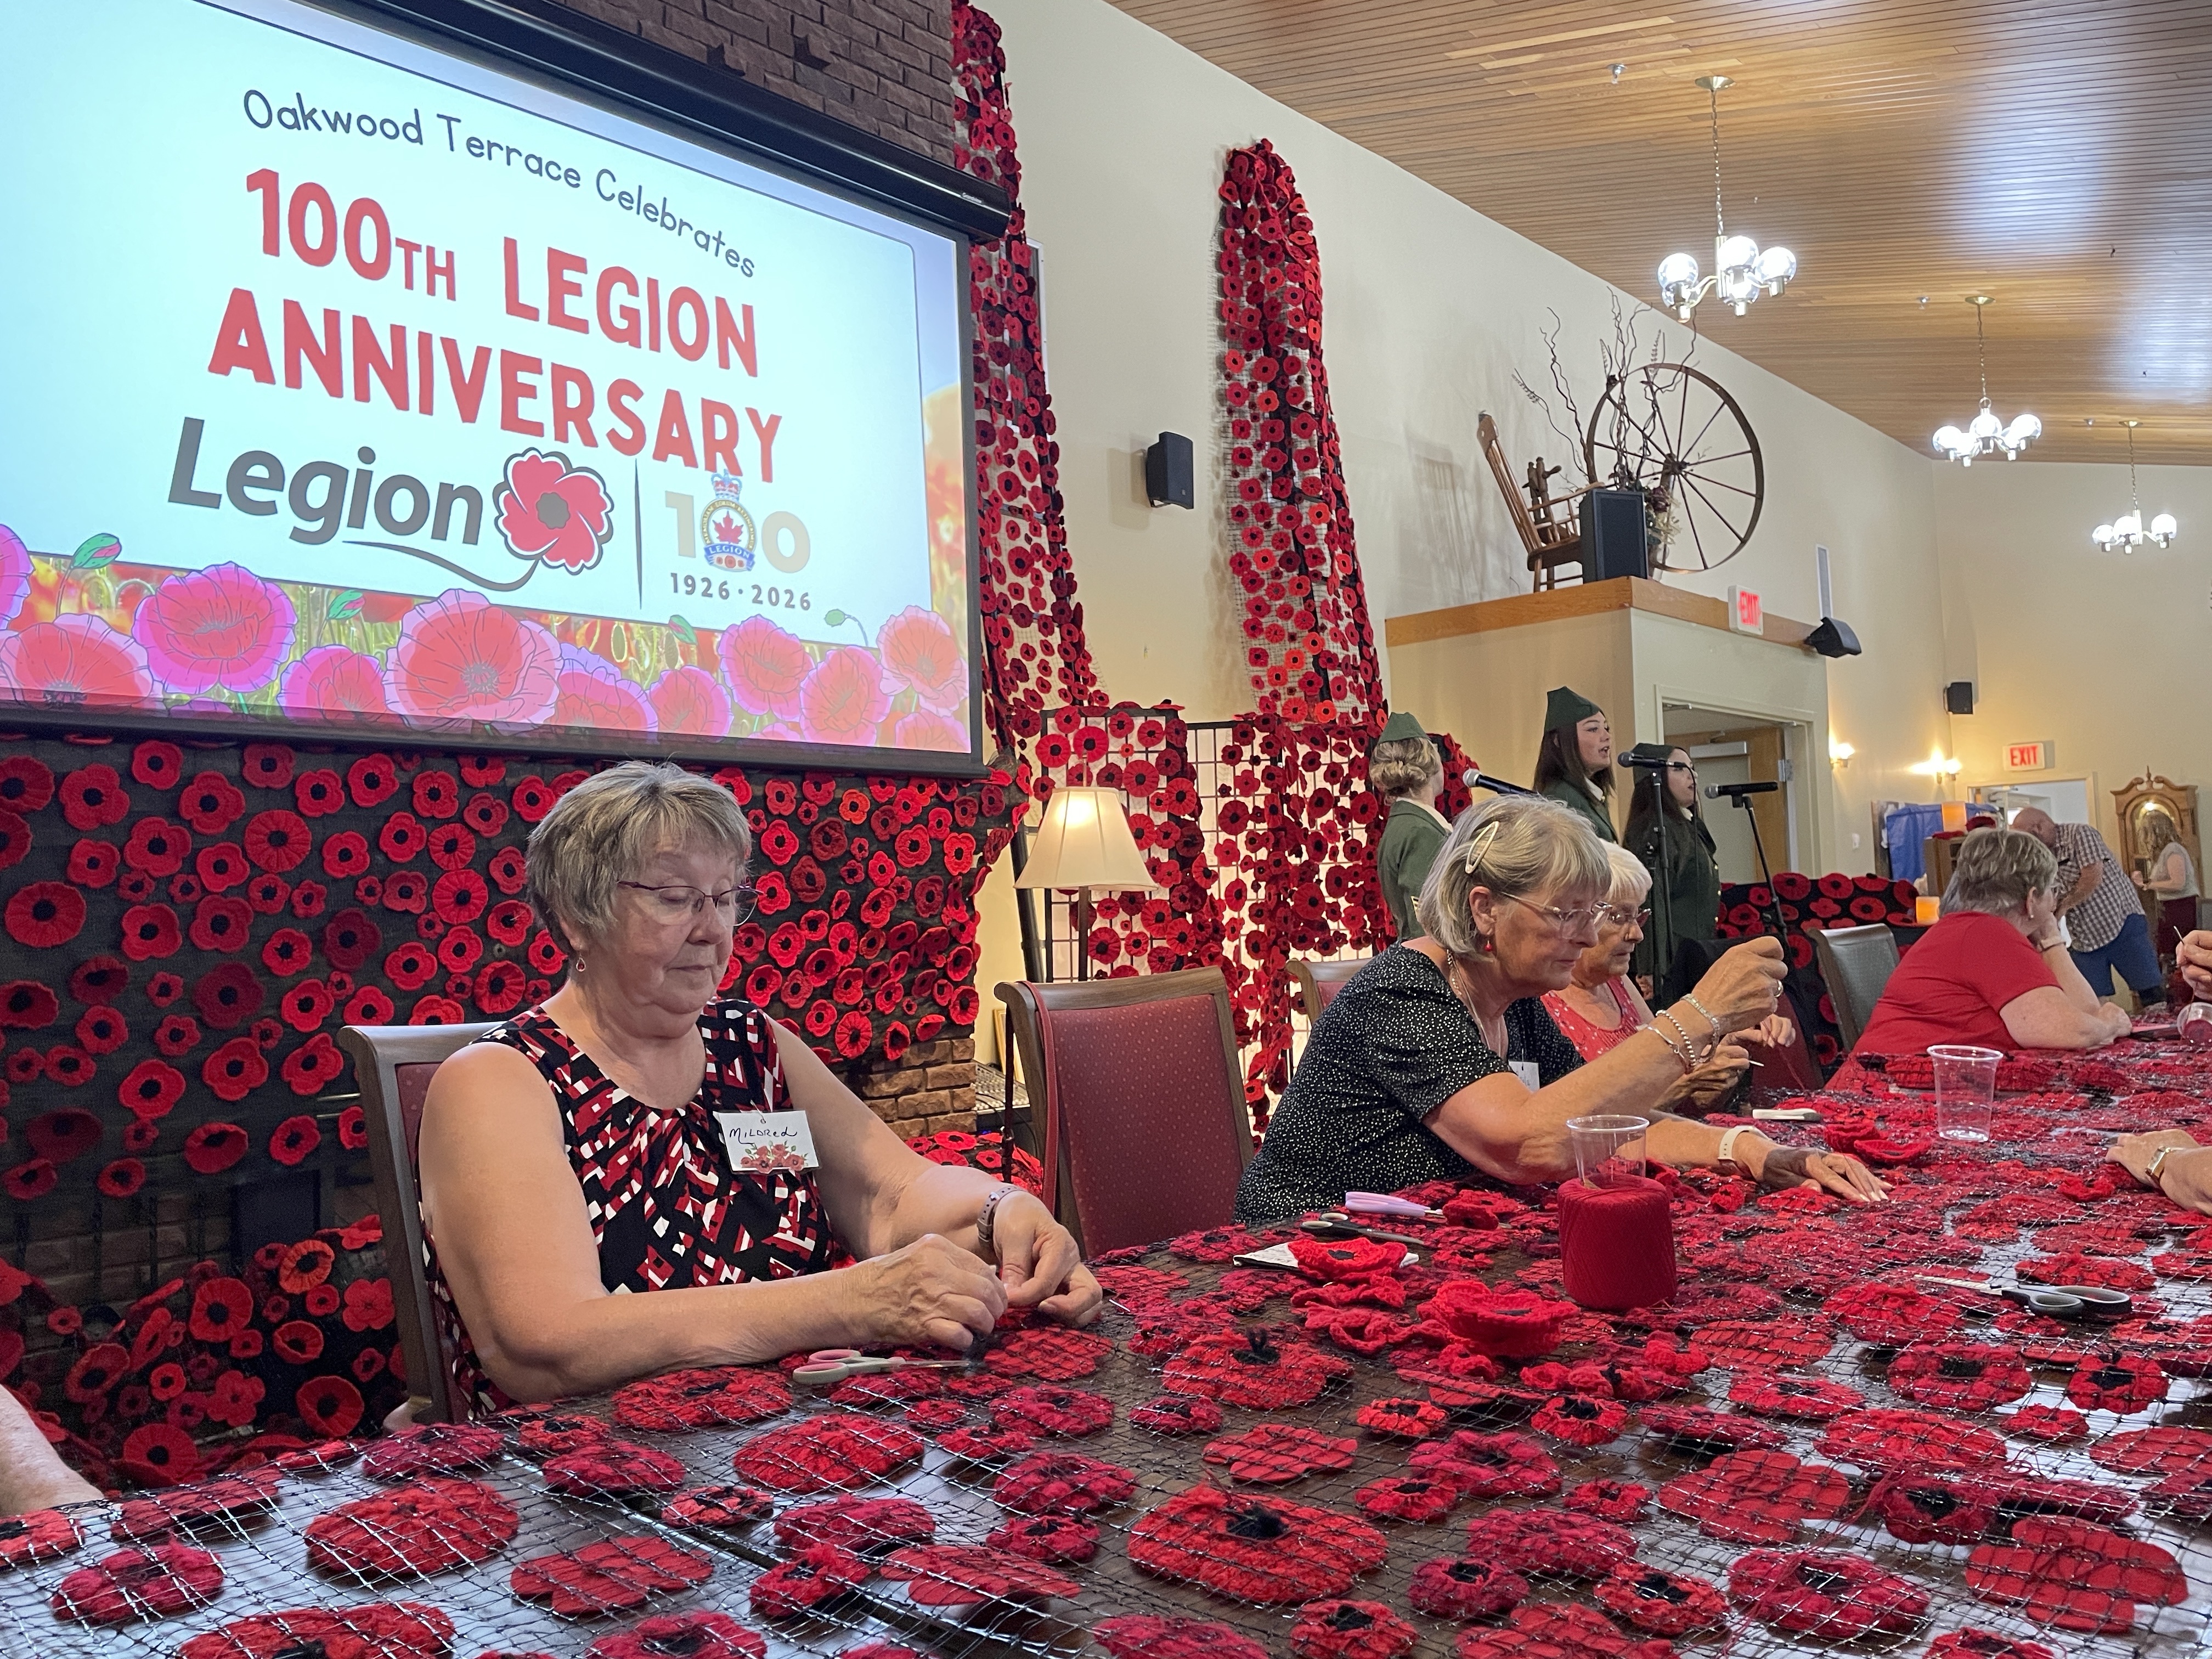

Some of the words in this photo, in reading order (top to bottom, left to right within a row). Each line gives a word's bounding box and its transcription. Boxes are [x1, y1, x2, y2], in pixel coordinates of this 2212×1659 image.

[244, 89, 424, 145] Oakwood
[436, 113, 581, 188] Terrace
[596, 168, 755, 278] Celebrates
[246, 168, 457, 302] 100TH
[503, 236, 758, 377] LEGION
[207, 287, 783, 484] ANNIVERSARY
[167, 416, 484, 546] Legion
[709, 545, 750, 559] LEGION
[1740, 591, 1759, 627] EXIT
[2010, 744, 2038, 767] EXIT
